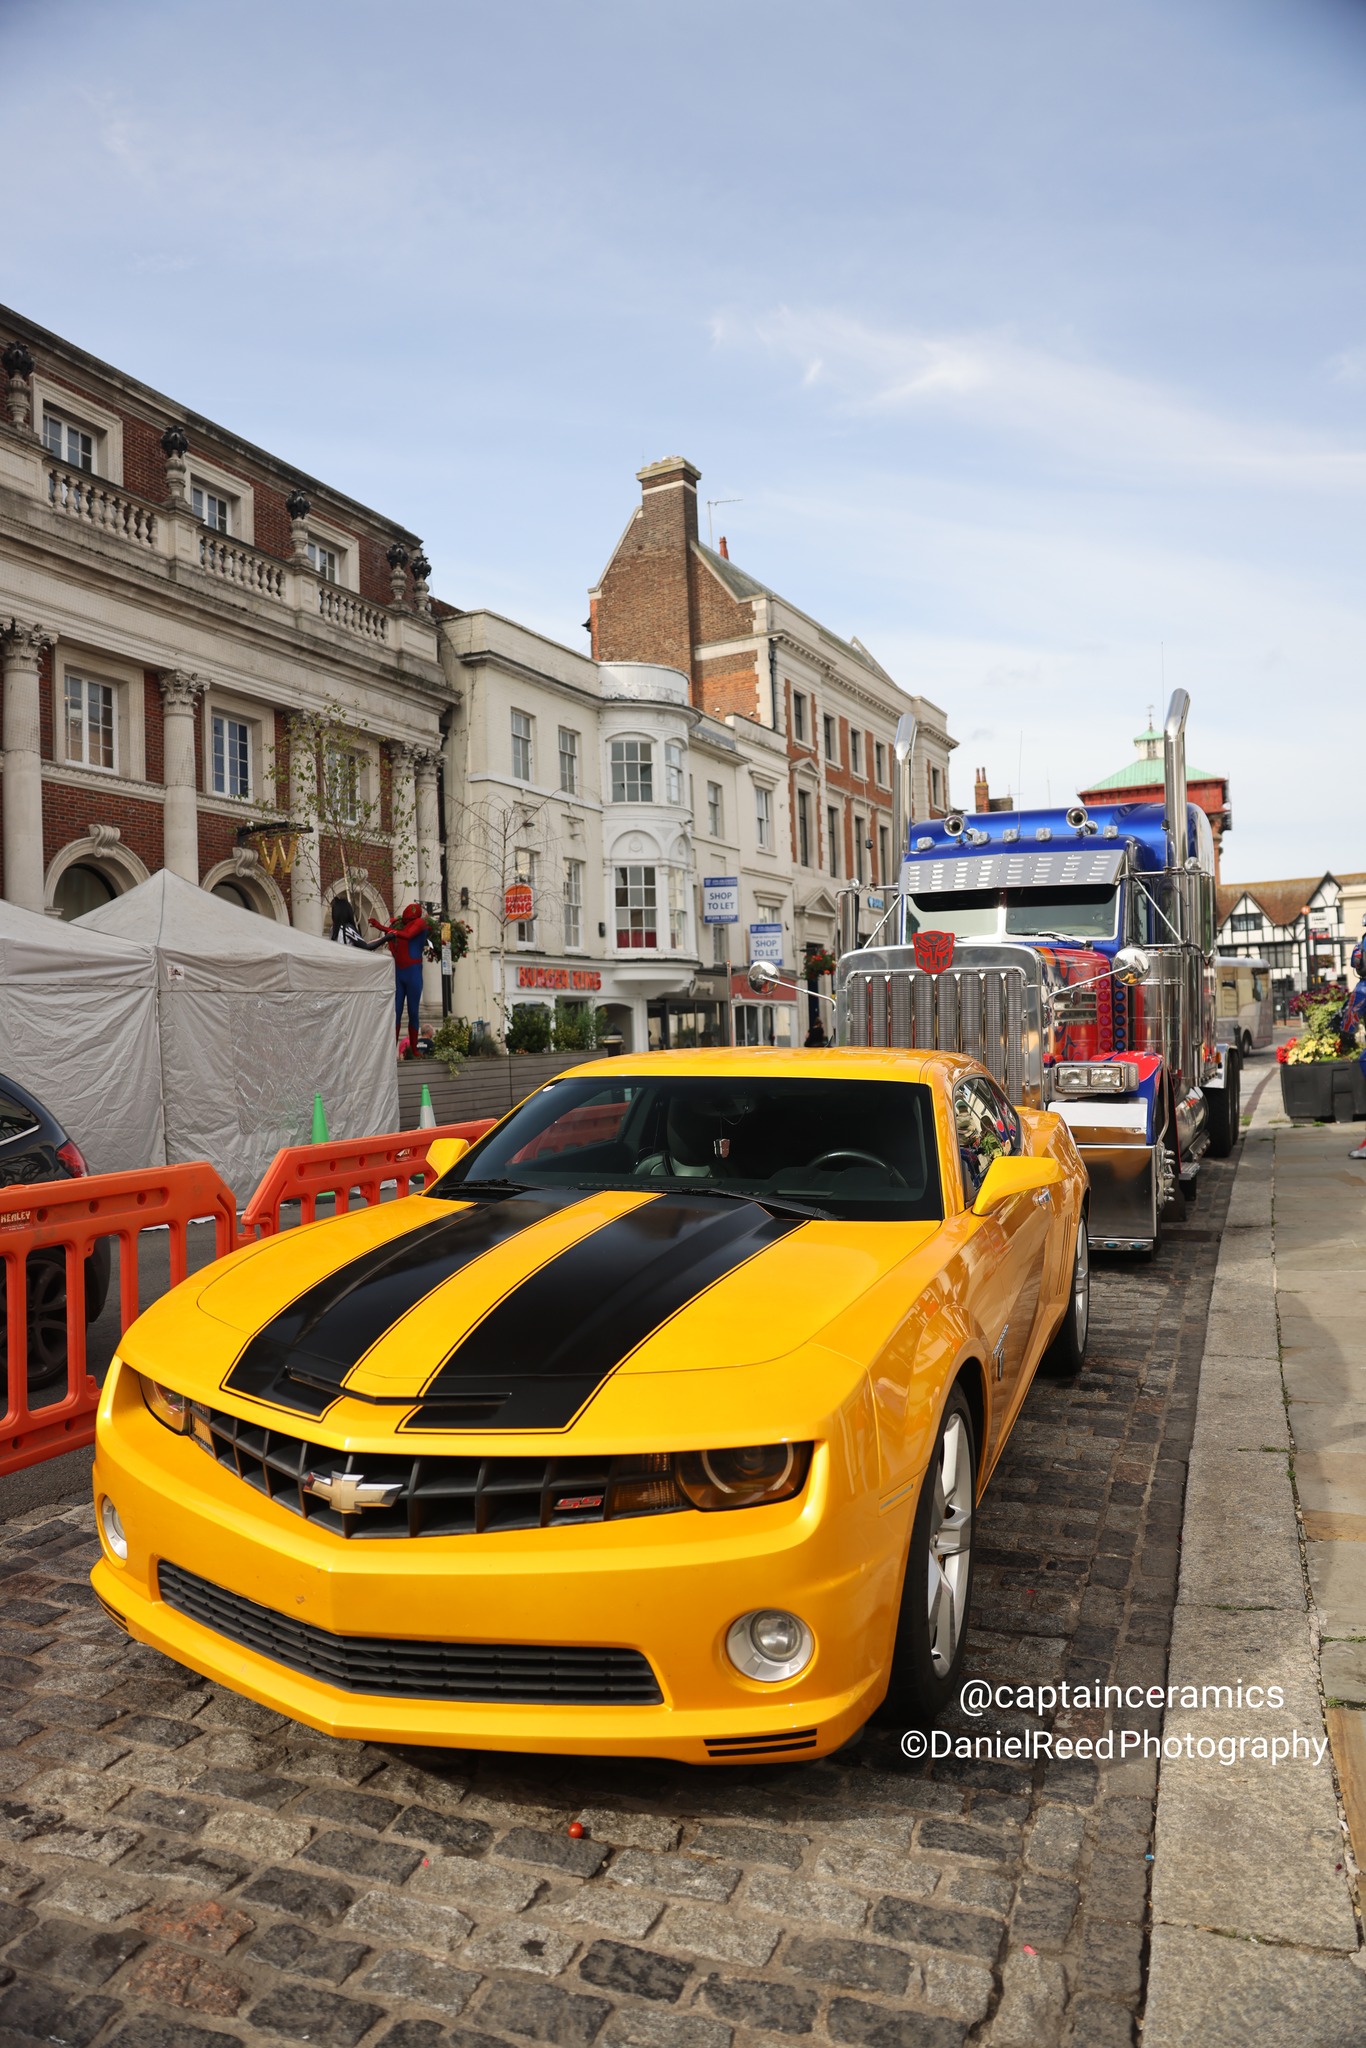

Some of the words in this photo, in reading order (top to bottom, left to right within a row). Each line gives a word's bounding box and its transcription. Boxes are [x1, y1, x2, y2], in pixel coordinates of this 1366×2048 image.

[505, 895, 532, 903] BURGER
[710, 892, 733, 900] SHOP
[505, 902, 532, 914] KING
[708, 902, 719, 910] TO
[720, 902, 735, 910] LET
[755, 939, 777, 948] SHOP
[753, 949, 764, 957] TO
[765, 949, 780, 957] LET
[517, 966, 570, 990] BURGER
[571, 970, 602, 991] KING
[554, 1495, 604, 1510] SS
